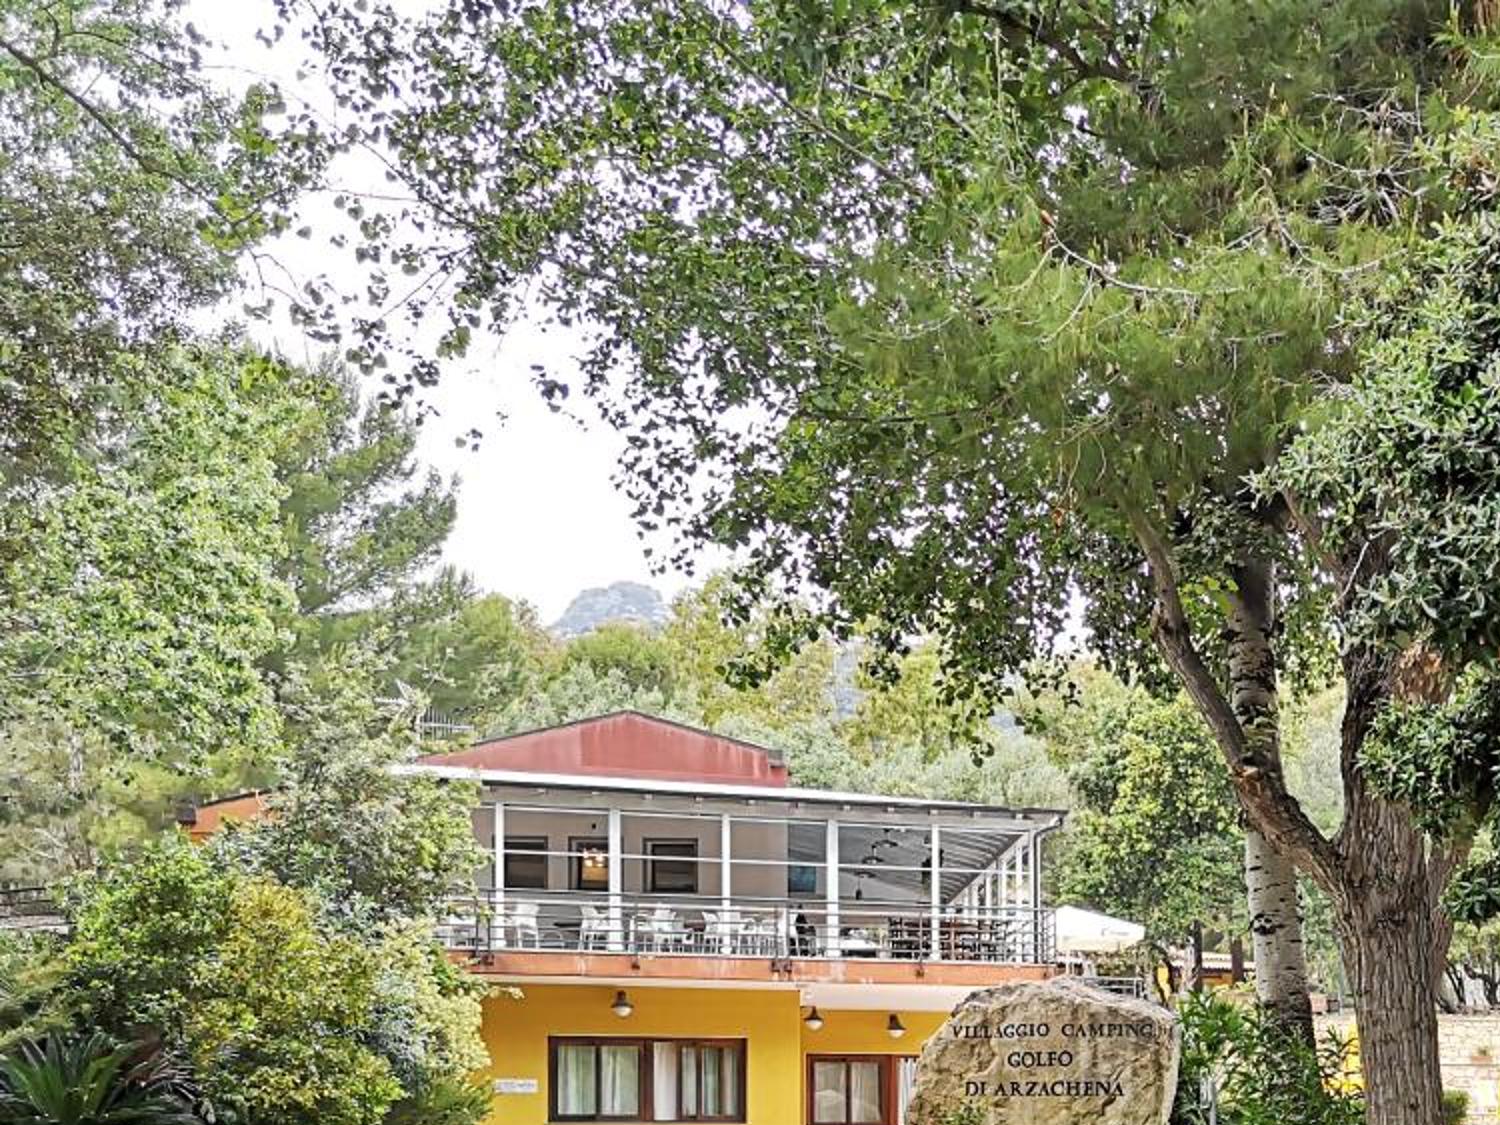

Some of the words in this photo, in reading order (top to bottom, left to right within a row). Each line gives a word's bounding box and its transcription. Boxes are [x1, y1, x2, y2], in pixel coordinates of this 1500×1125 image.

[952, 1023, 1050, 1039] VILLAGGIO
[1061, 1023, 1155, 1039] CAMPING
[1007, 1050, 1073, 1068] GOLFO
[965, 1081, 986, 1097] DI
[996, 1080, 1125, 1097] ARZACHENA
